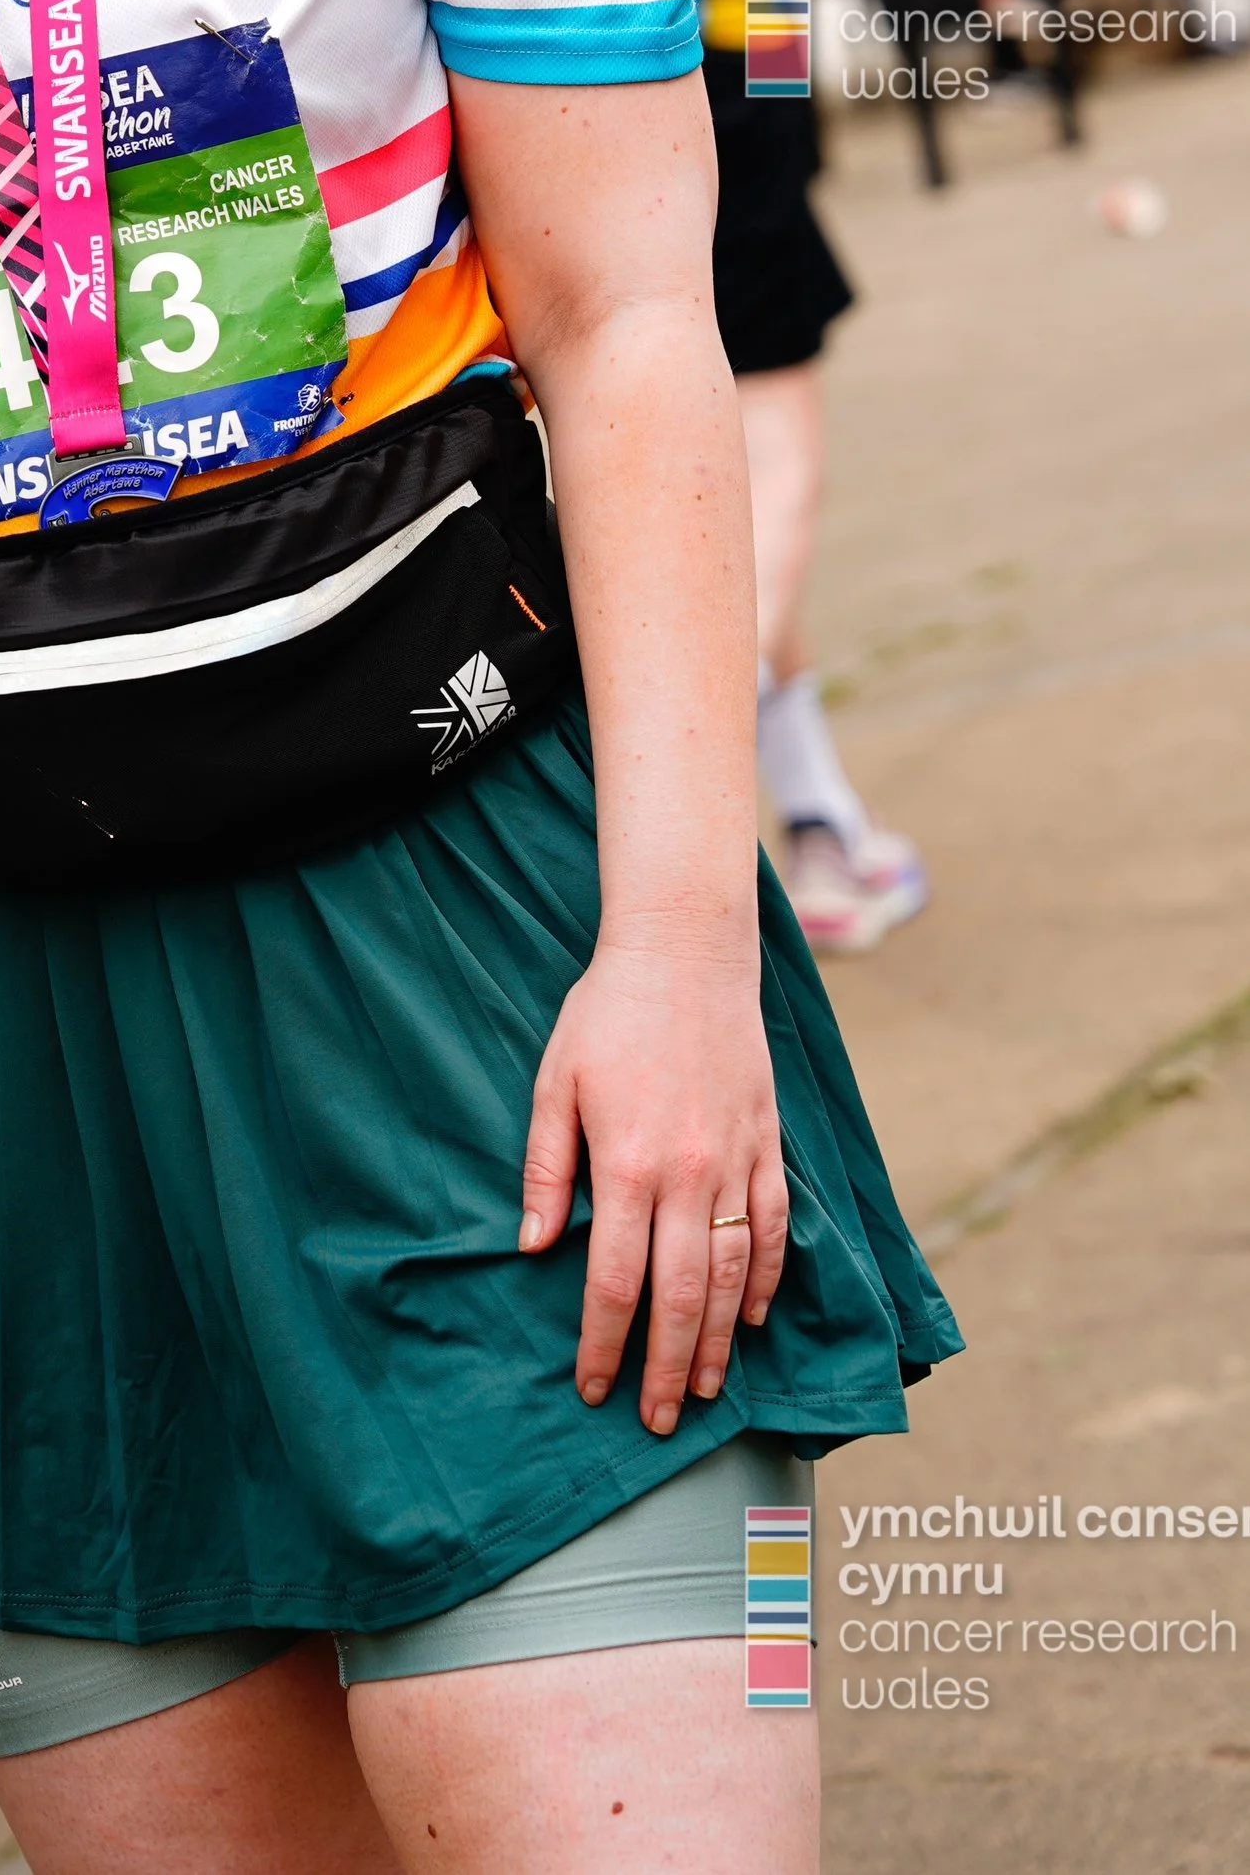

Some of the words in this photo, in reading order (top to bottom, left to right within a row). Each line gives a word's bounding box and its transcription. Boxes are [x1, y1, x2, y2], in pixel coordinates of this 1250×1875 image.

[106, 132, 176, 160] ABERTAWE
[209, 154, 297, 194] CANCER
[117, 204, 231, 246] RESEARCH
[231, 185, 305, 221] WALES
[104, 462, 166, 479] Marathon
[83, 476, 142, 500] Abertawe
